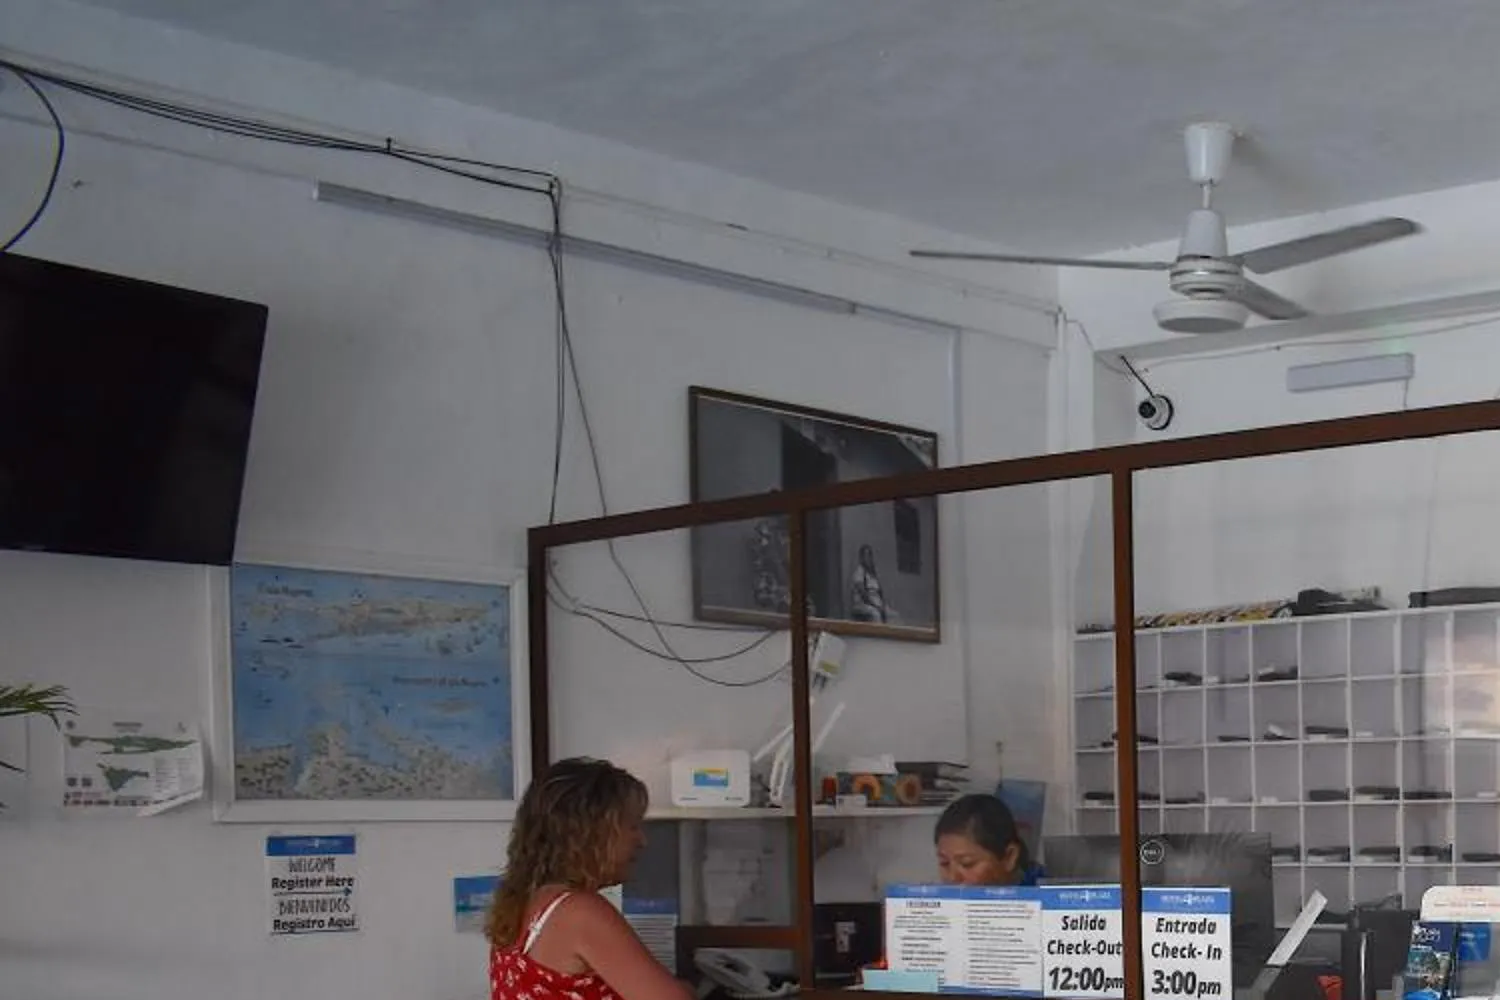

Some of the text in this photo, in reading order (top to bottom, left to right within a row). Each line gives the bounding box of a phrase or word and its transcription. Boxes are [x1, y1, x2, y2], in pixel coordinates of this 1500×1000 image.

[272, 876, 354, 890] Register Here
[273, 918, 325, 933] Registro
[1061, 915, 1107, 931] Salida
[1155, 917, 1217, 935] Entrada
[1047, 940, 1123, 955] Check-Out
